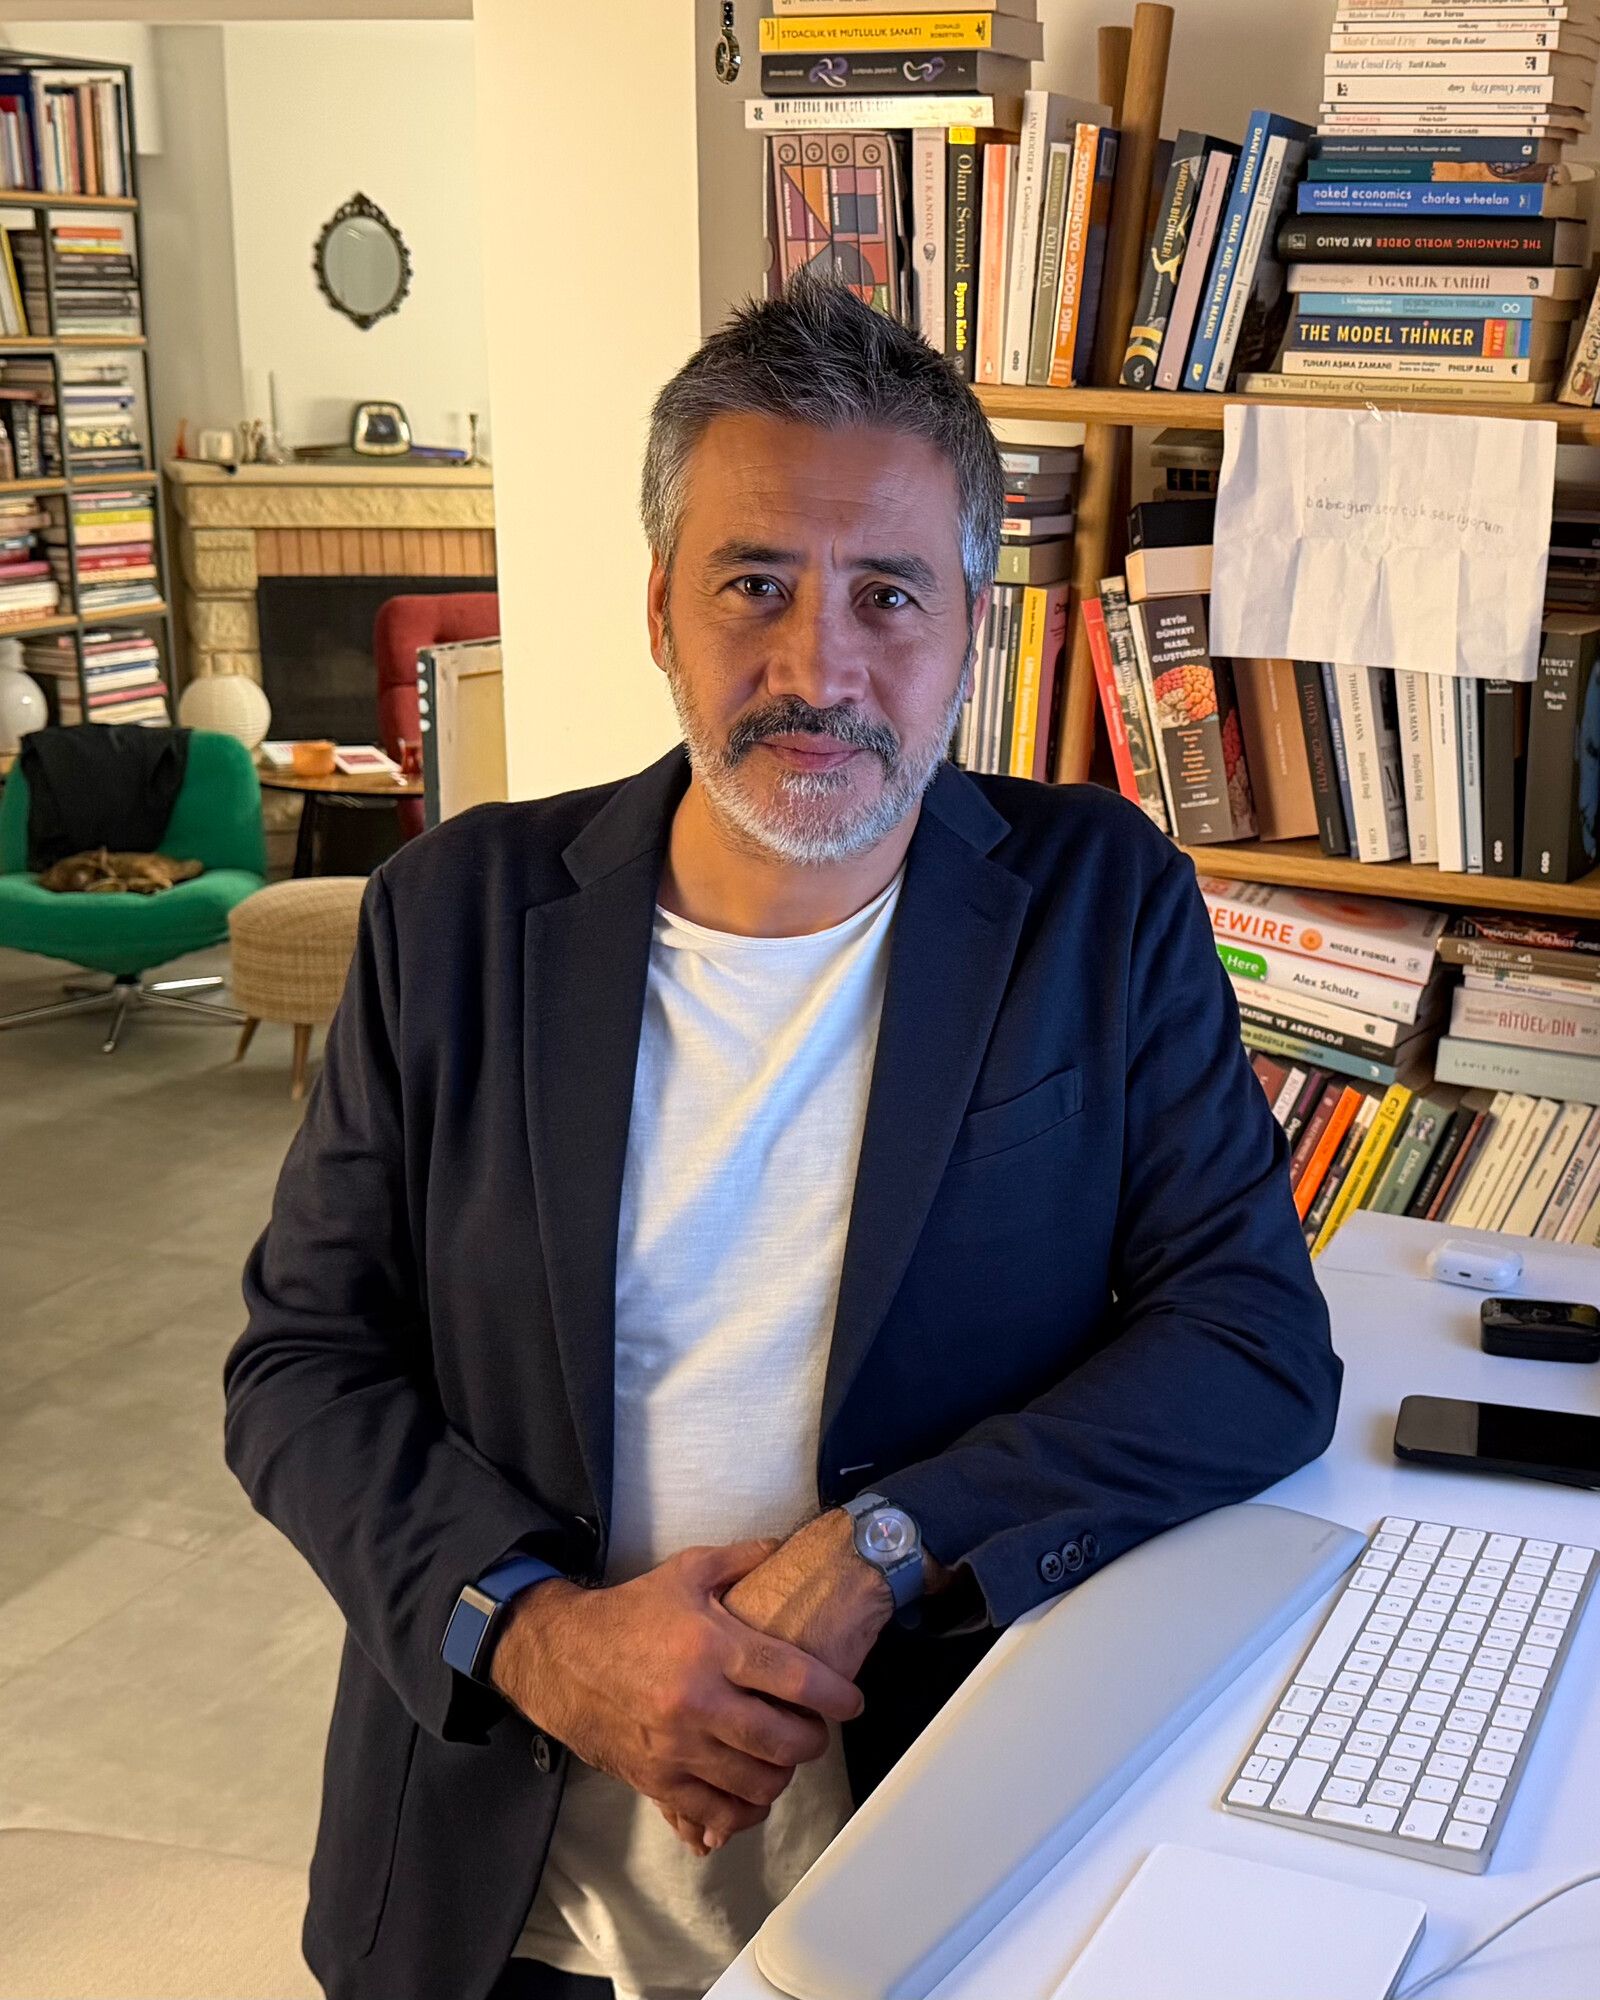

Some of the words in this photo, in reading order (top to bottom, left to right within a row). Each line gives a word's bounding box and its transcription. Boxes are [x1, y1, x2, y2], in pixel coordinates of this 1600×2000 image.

[828, 30, 838, 38] VE
[839, 28, 887, 38] MUTLULUK
[889, 27, 922, 37] SANATI
[1069, 147, 1092, 251] DASHBOARDS
[1313, 185, 1348, 200] naked
[1351, 188, 1412, 200] economics
[1421, 192, 1462, 205] charles
[1463, 192, 1510, 206] wheelan
[1228, 214, 1242, 244] DAHA
[955, 207, 972, 273] Sevmek
[1316, 236, 1350, 247] DALIO
[1352, 236, 1374, 248] RAY
[1376, 237, 1412, 248] ORDER
[1414, 238, 1453, 249] WORLD
[1456, 239, 1520, 250] CHANGING
[1522, 239, 1541, 250] THE
[1062, 265, 1077, 305] BOOK
[1212, 274, 1227, 303] DAHA
[1368, 275, 1438, 289] UYGARLIK
[1060, 309, 1073, 333] BIG
[1203, 305, 1220, 340] MAKUL
[1299, 324, 1331, 341] THE
[1337, 325, 1393, 344] MODEL
[1400, 321, 1475, 346] THINKER
[1448, 364, 1474, 373] PHILIP
[1475, 365, 1495, 374] BALL
[1262, 377, 1280, 388] The
[1281, 378, 1307, 389] Visual
[1310, 379, 1342, 393] Display
[1343, 380, 1354, 391] of
[1155, 626, 1195, 639] DÜNYAYI
[1163, 639, 1191, 650] NASIL
[1151, 647, 1205, 663] OLUŞTURDU
[1541, 657, 1575, 668] TURGUT
[1545, 667, 1569, 677] UYAR
[1348, 672, 1360, 713] THOMAS
[1406, 674, 1417, 714] THOMAS
[1353, 713, 1364, 741] MANN
[1409, 714, 1419, 742] MANN
[1208, 907, 1294, 945] EWIRE
[1329, 942, 1359, 956] NICOLE
[1361, 950, 1397, 964] VIGNOLA
[1456, 943, 1511, 961] Pragmatic
[1226, 954, 1260, 974] Here
[1472, 955, 1534, 973] Programmer
[1292, 973, 1317, 988] Alex
[1320, 980, 1361, 999] Schultz
[1276, 1018, 1288, 1029] VE
[1551, 1017, 1577, 1038] DİN
